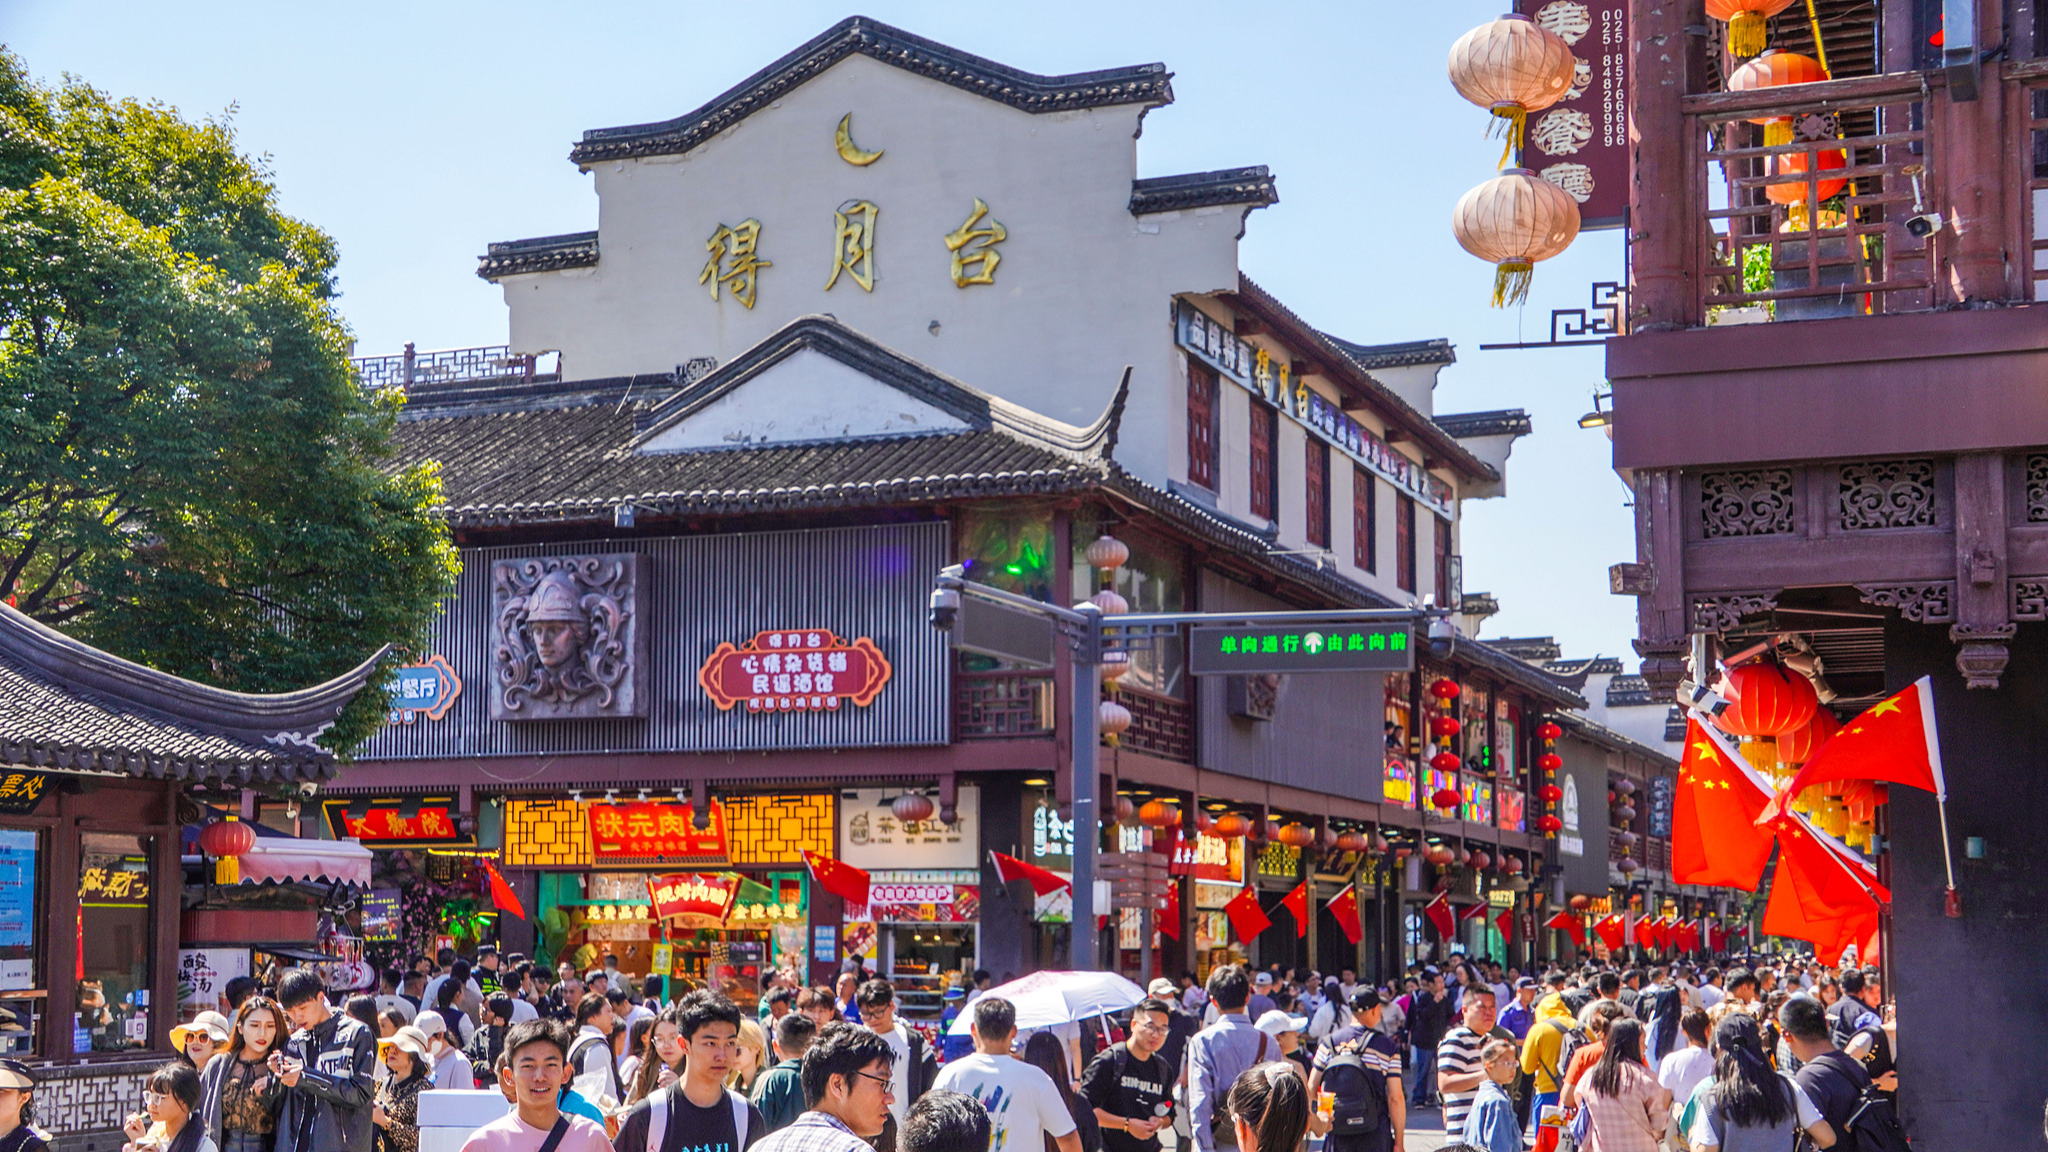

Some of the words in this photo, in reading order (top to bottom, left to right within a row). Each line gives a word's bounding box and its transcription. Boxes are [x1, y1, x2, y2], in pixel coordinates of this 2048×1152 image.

[1602, 10, 1613, 147] 025-84829999
[1614, 8, 1625, 146] 025-85766666
[699, 198, 1007, 310] 得月台
[1255, 348, 1308, 418] 得月台
[1220, 635, 1300, 654] 单向通行
[1327, 631, 1407, 652] 由此向前
[741, 652, 847, 674] 心情杂货铺
[752, 673, 834, 693] 民谣酒馆
[0, 773, 46, 801] 票处
[1121, 1075, 1163, 1096] SINULA
